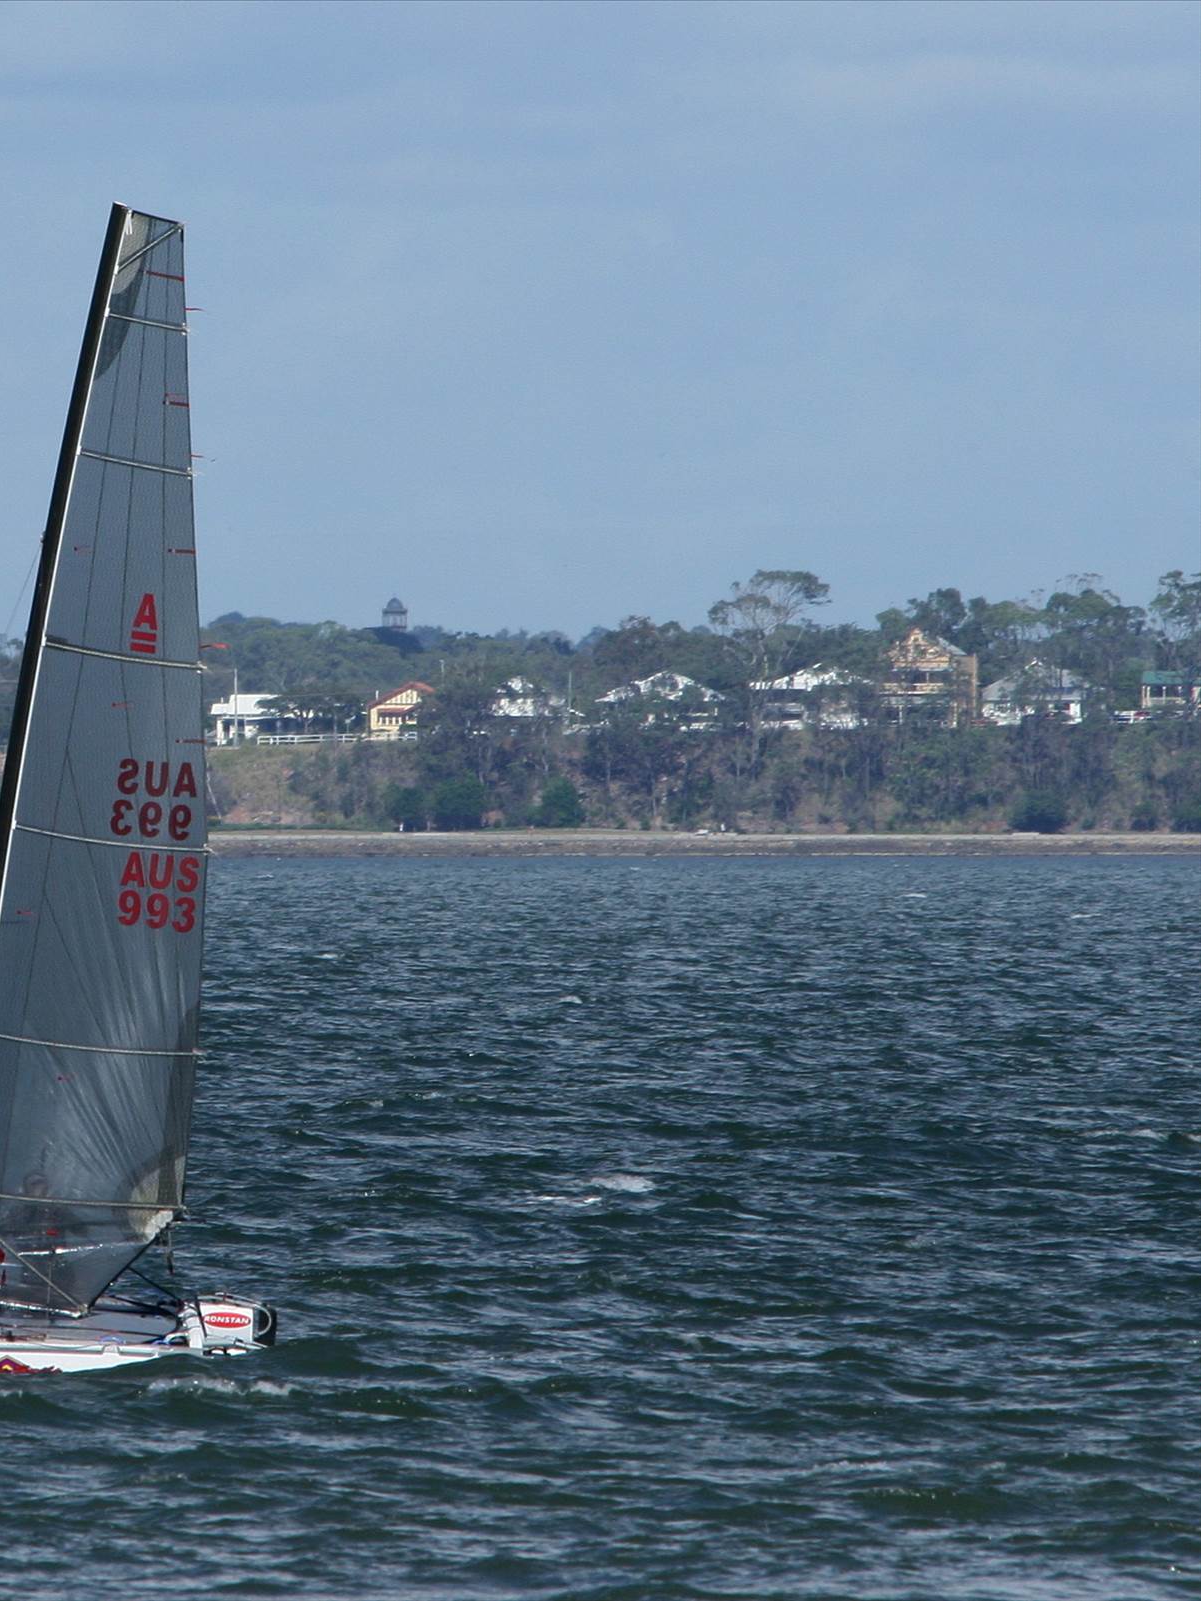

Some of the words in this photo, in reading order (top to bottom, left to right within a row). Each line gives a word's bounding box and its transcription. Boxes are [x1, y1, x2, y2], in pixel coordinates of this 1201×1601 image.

[132, 593, 158, 631] A
[120, 851, 200, 893] AUS
[118, 889, 196, 933] 993
[203, 1314, 250, 1325] RONSTAN
